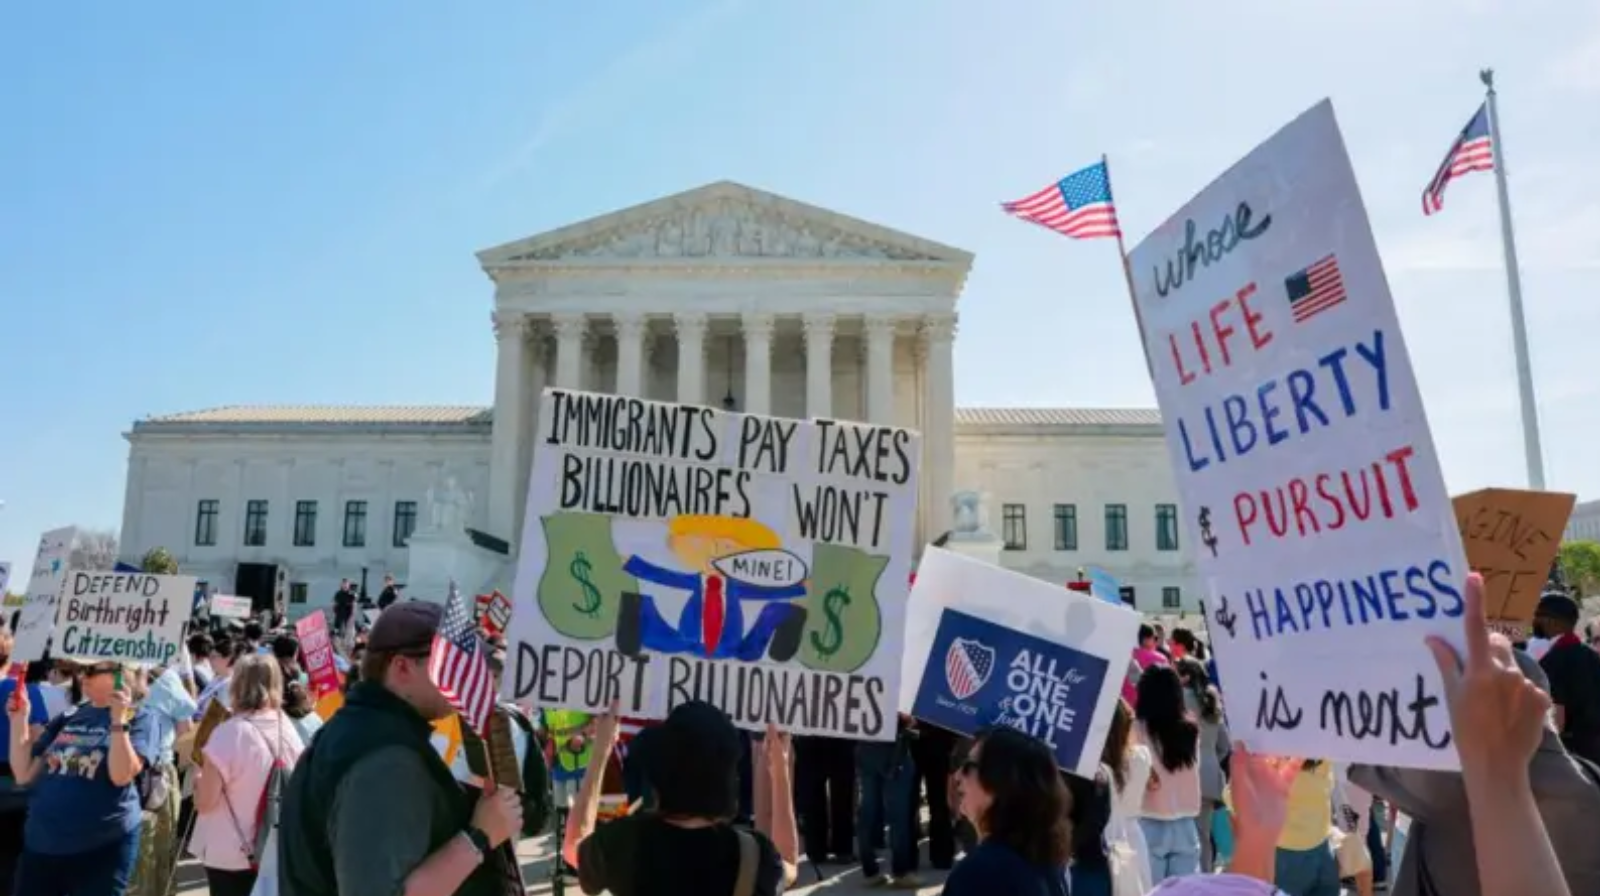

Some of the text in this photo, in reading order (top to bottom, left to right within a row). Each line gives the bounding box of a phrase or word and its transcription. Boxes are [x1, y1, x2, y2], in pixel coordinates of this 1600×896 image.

[1154, 201, 1271, 296] whose
[1169, 282, 1273, 385] LIFE
[546, 391, 910, 485] IMMIGRANTS PAY TAXES
[1178, 329, 1389, 472] LIBERTY
[560, 453, 889, 547] BILLIONAIRES WON'T
[1233, 446, 1419, 545] PURSUIT
[66, 597, 169, 633] Birthright
[74, 572, 160, 597] DEFEND
[1245, 560, 1465, 640] HAPPINESS
[62, 625, 176, 668] Citizenship
[514, 641, 650, 712] DEPORT
[1010, 649, 1060, 683] ALL
[1007, 669, 1069, 707] ONE
[1013, 693, 1076, 732] ONE
[1255, 671, 1452, 749] is next
